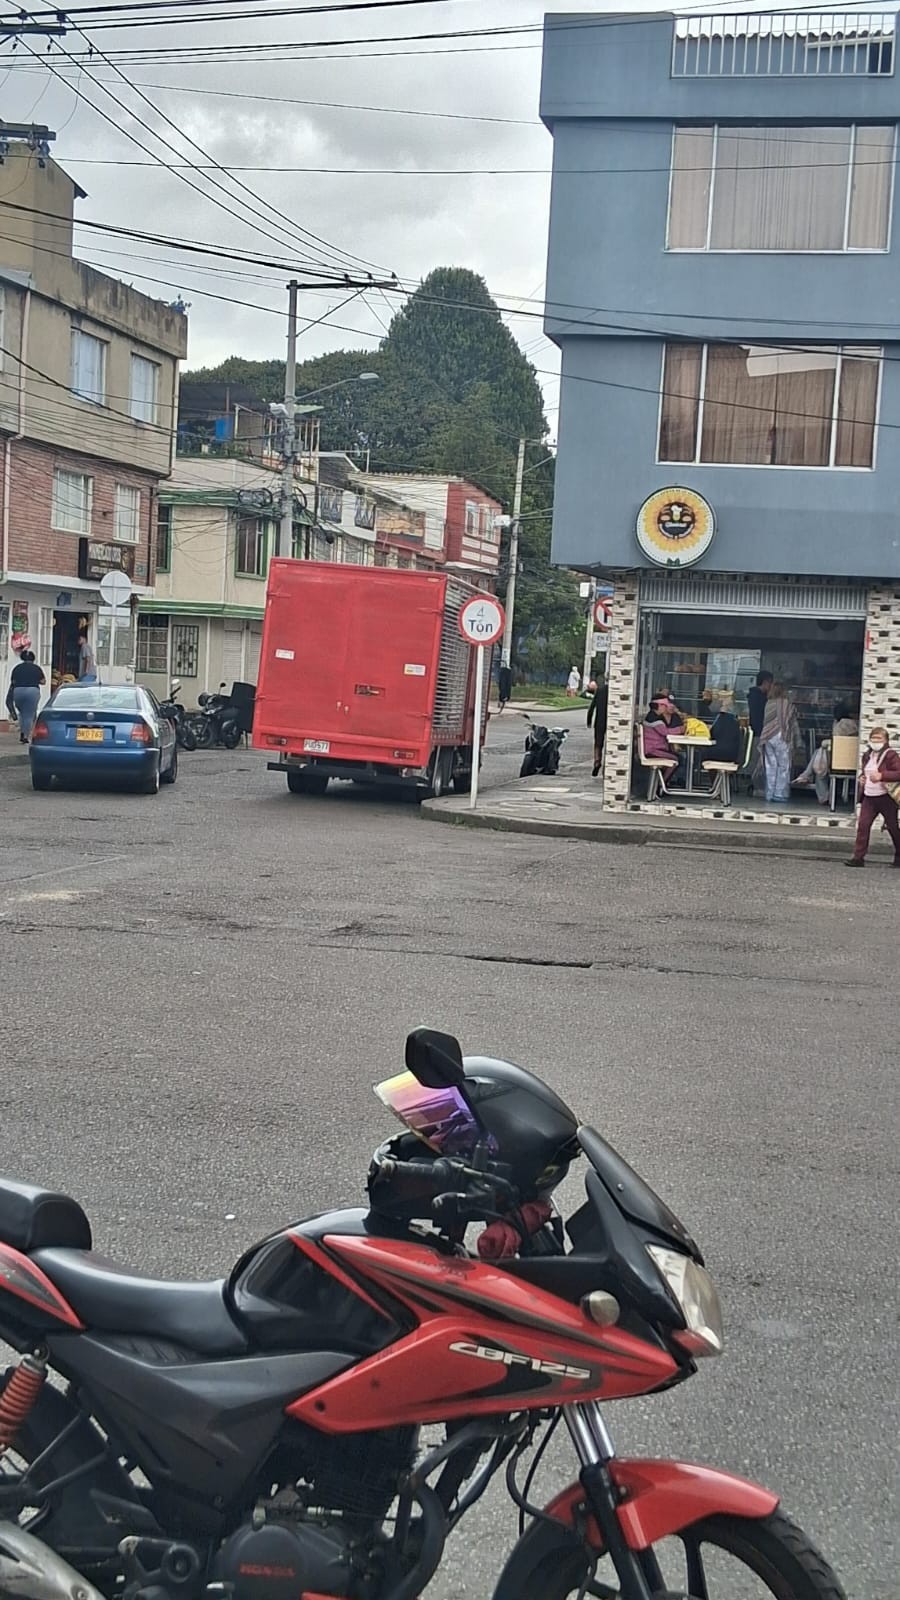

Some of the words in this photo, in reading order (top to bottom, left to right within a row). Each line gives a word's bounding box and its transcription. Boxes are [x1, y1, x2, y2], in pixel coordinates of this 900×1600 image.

[476, 605, 485, 617] 4
[449, 1341, 592, 1380] CBF125
[239, 1563, 297, 1578] HONDA
